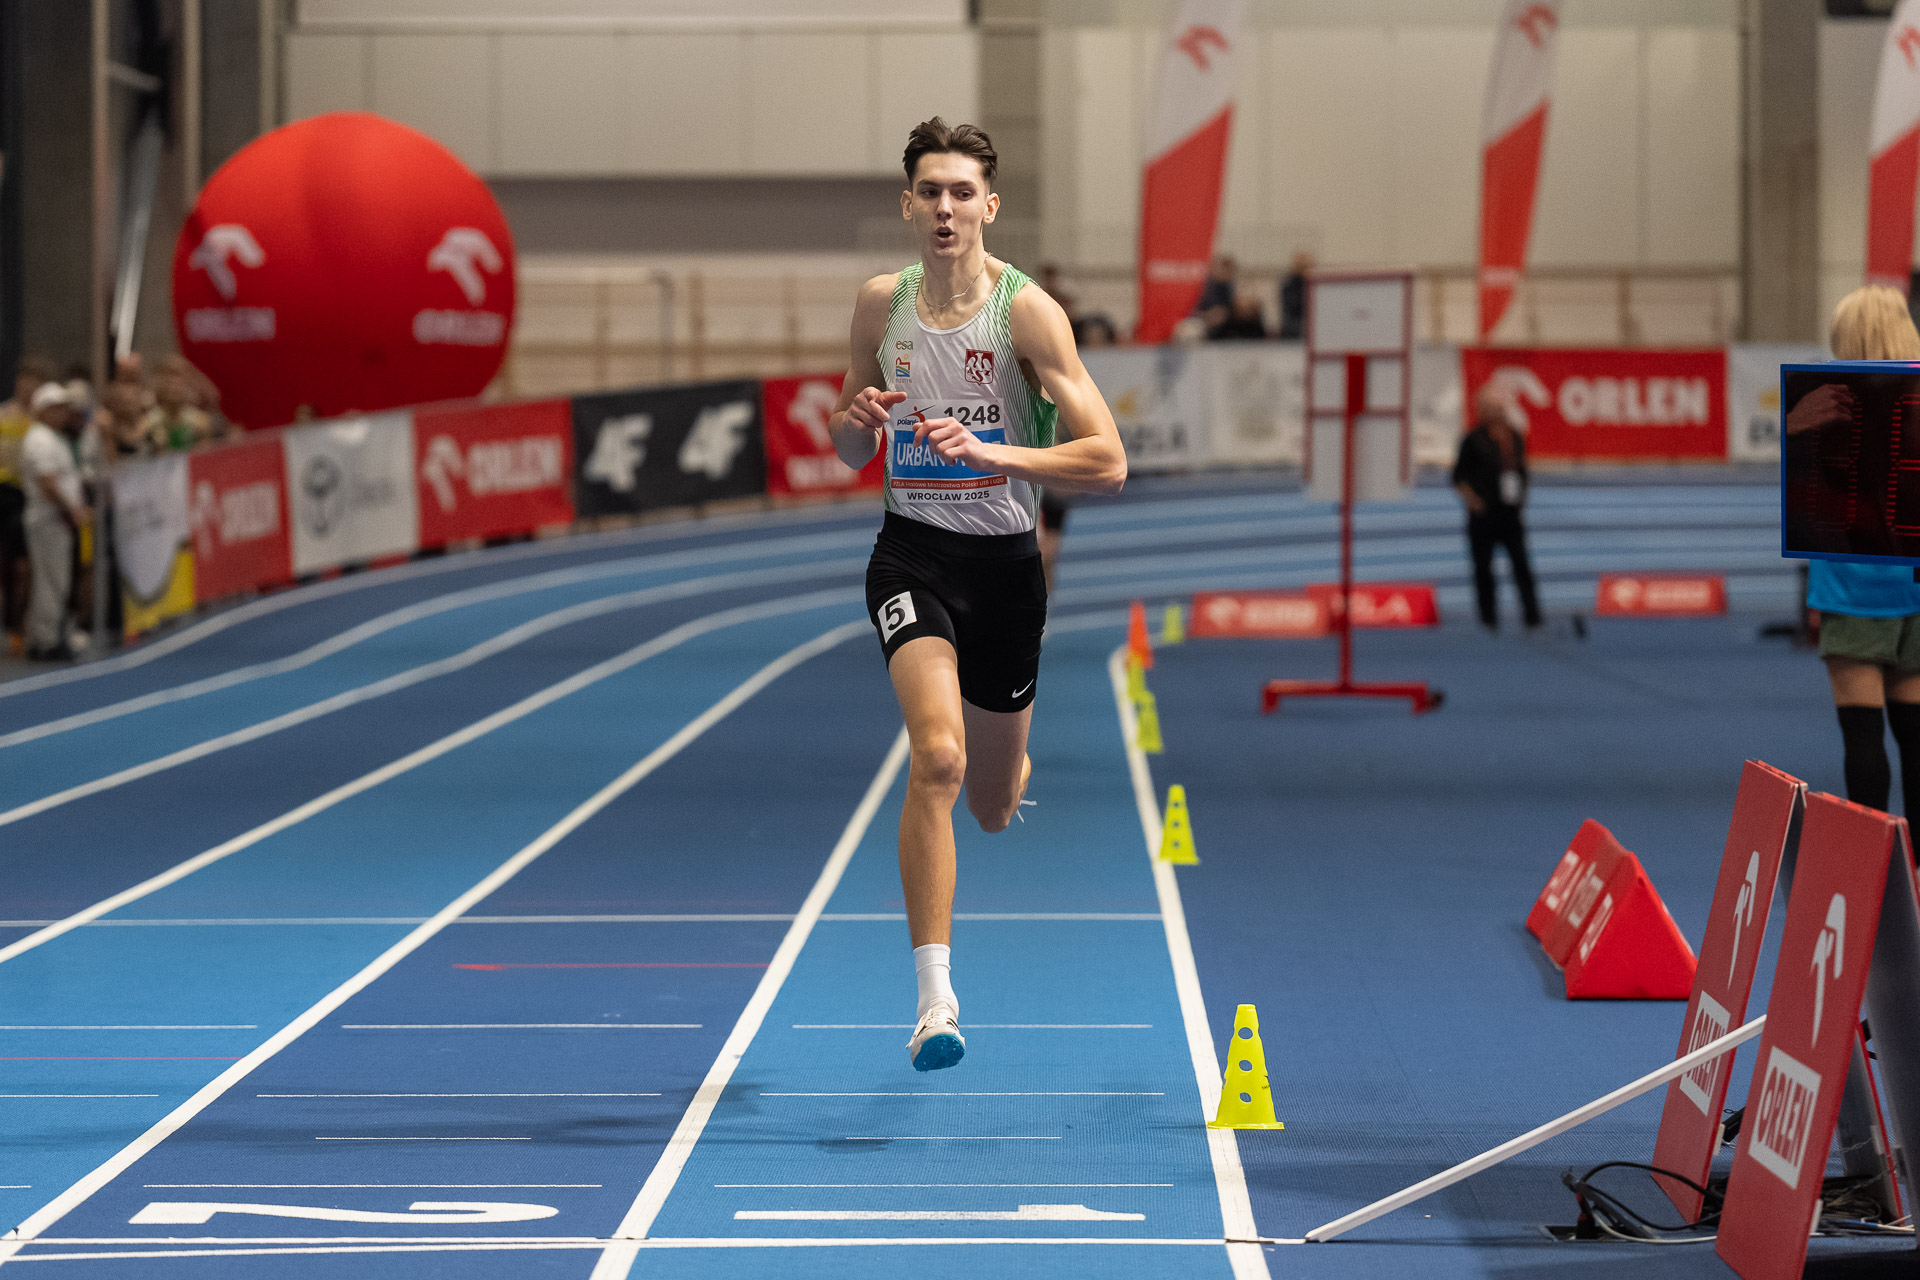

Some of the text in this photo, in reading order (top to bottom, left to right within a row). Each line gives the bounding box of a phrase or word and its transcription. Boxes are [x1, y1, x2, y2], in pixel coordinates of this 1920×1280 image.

[896, 340, 914, 351] esa
[944, 404, 1001, 426] 1248
[1557, 377, 1710, 427] ORLEN
[584, 413, 652, 492] 4F
[679, 402, 755, 480] 4F
[907, 490, 990, 501] WROCŁAW 2025
[961, 479, 978, 488] Polski
[885, 597, 906, 631] 5
[1756, 1066, 1815, 1169] ORLEN
